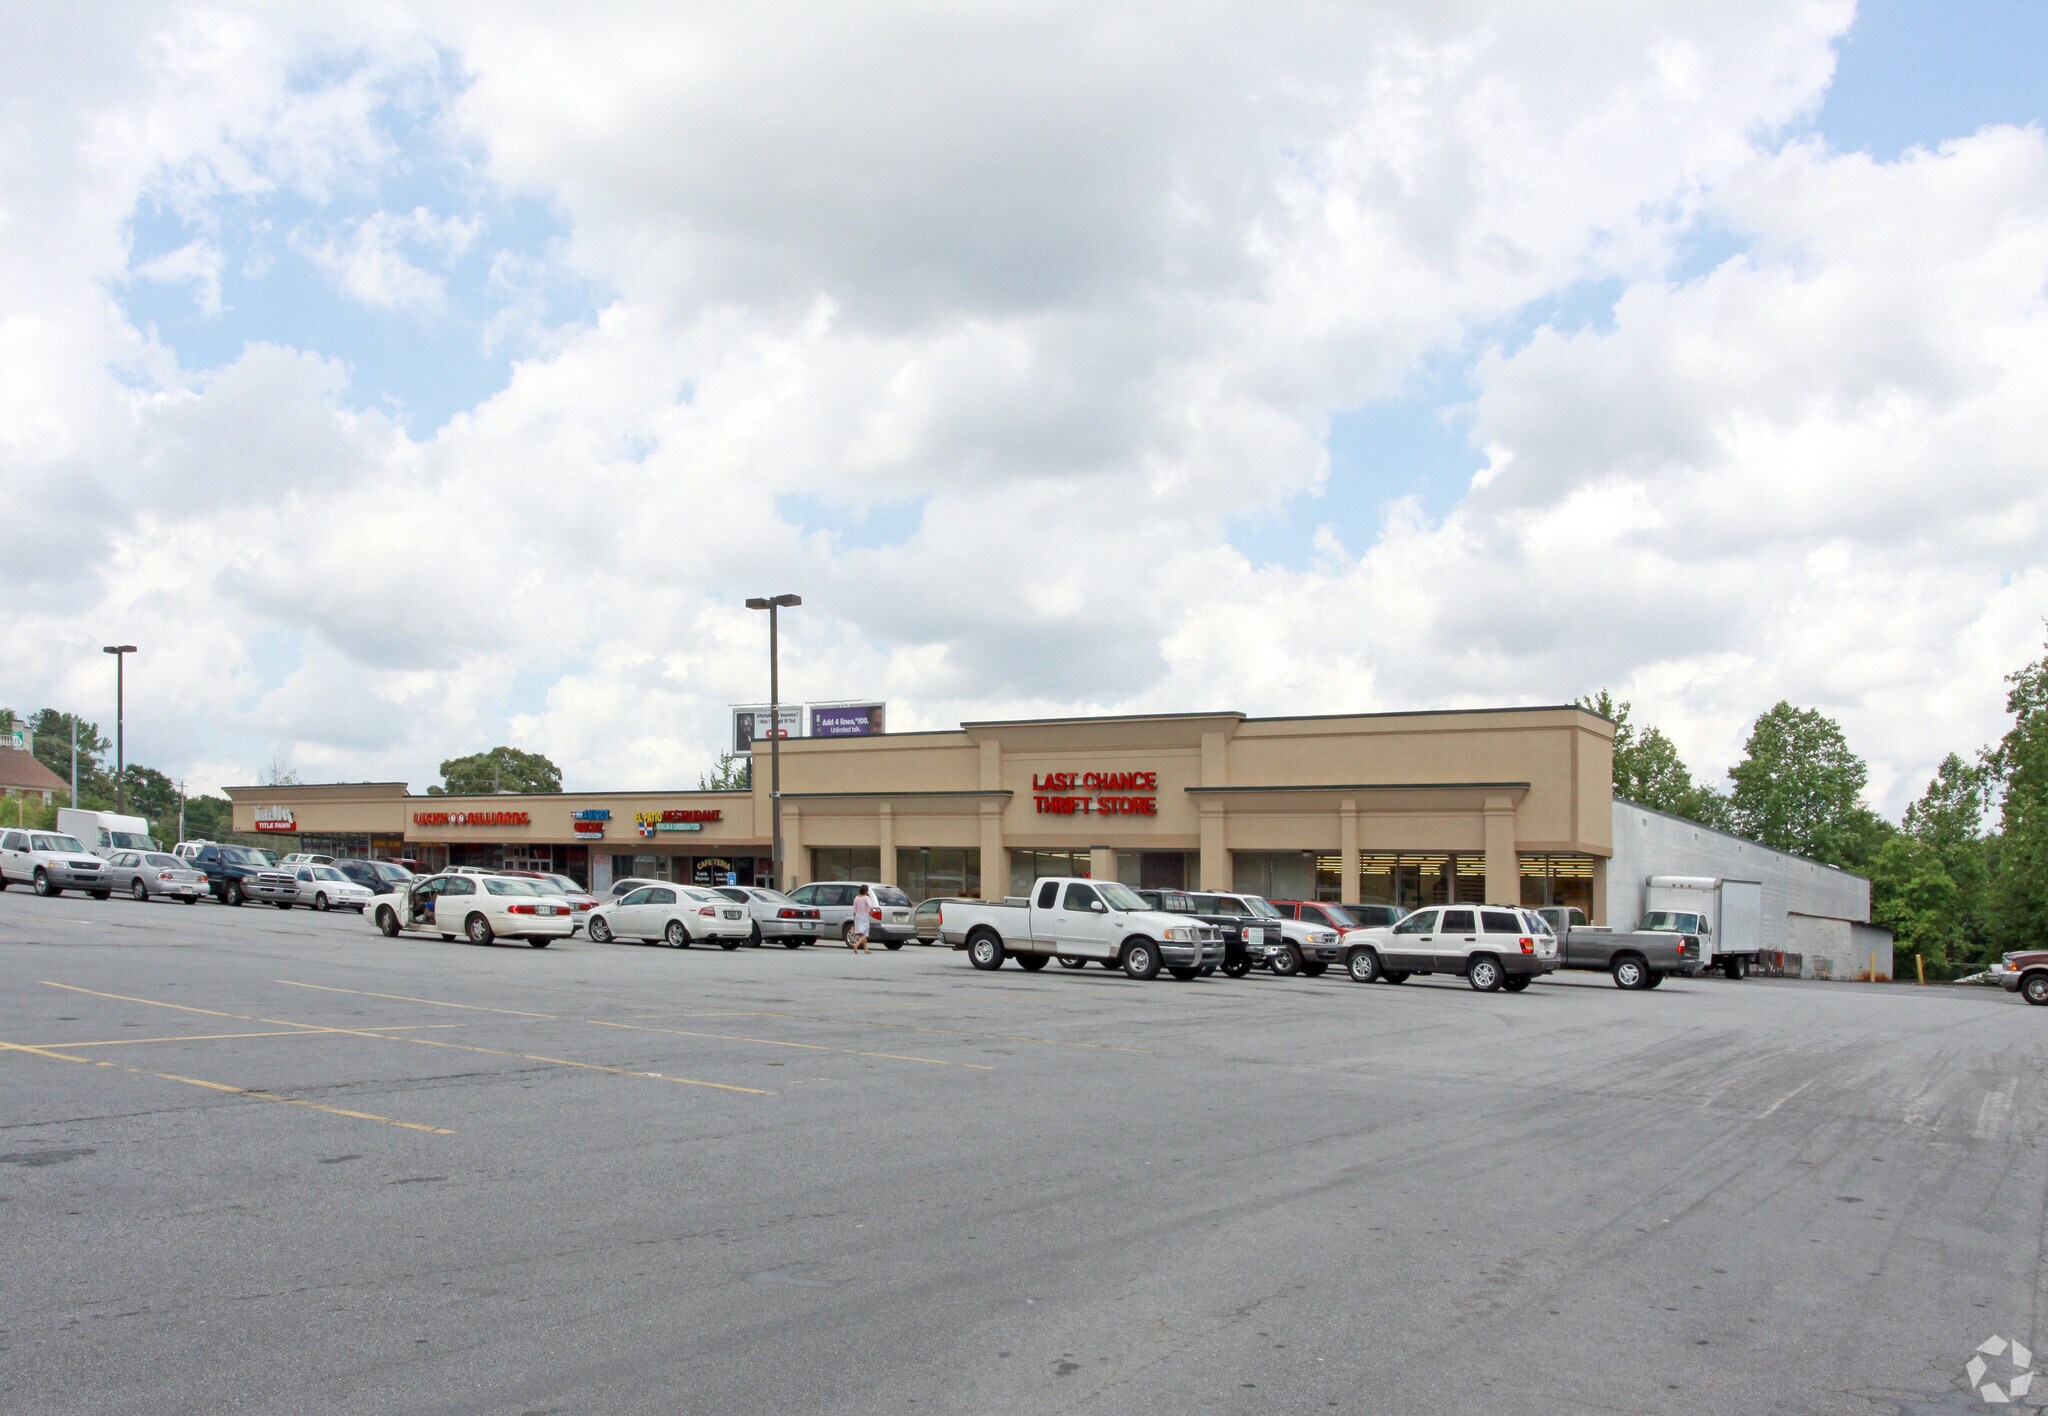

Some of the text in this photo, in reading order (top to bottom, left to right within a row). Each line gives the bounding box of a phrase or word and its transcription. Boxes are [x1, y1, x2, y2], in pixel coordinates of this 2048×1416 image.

[822, 718, 834, 726] Add
[830, 726, 851, 734] Unlimited
[1032, 772, 1157, 791] LAST CHANCE
[1033, 796, 1157, 815] THRIFT STORE
[413, 812, 448, 825] LUCKY
[467, 811, 529, 825] BILLIARDS
[583, 809, 609, 819] AMIGOS
[634, 810, 721, 822] EL PATIO RESTAURANT
